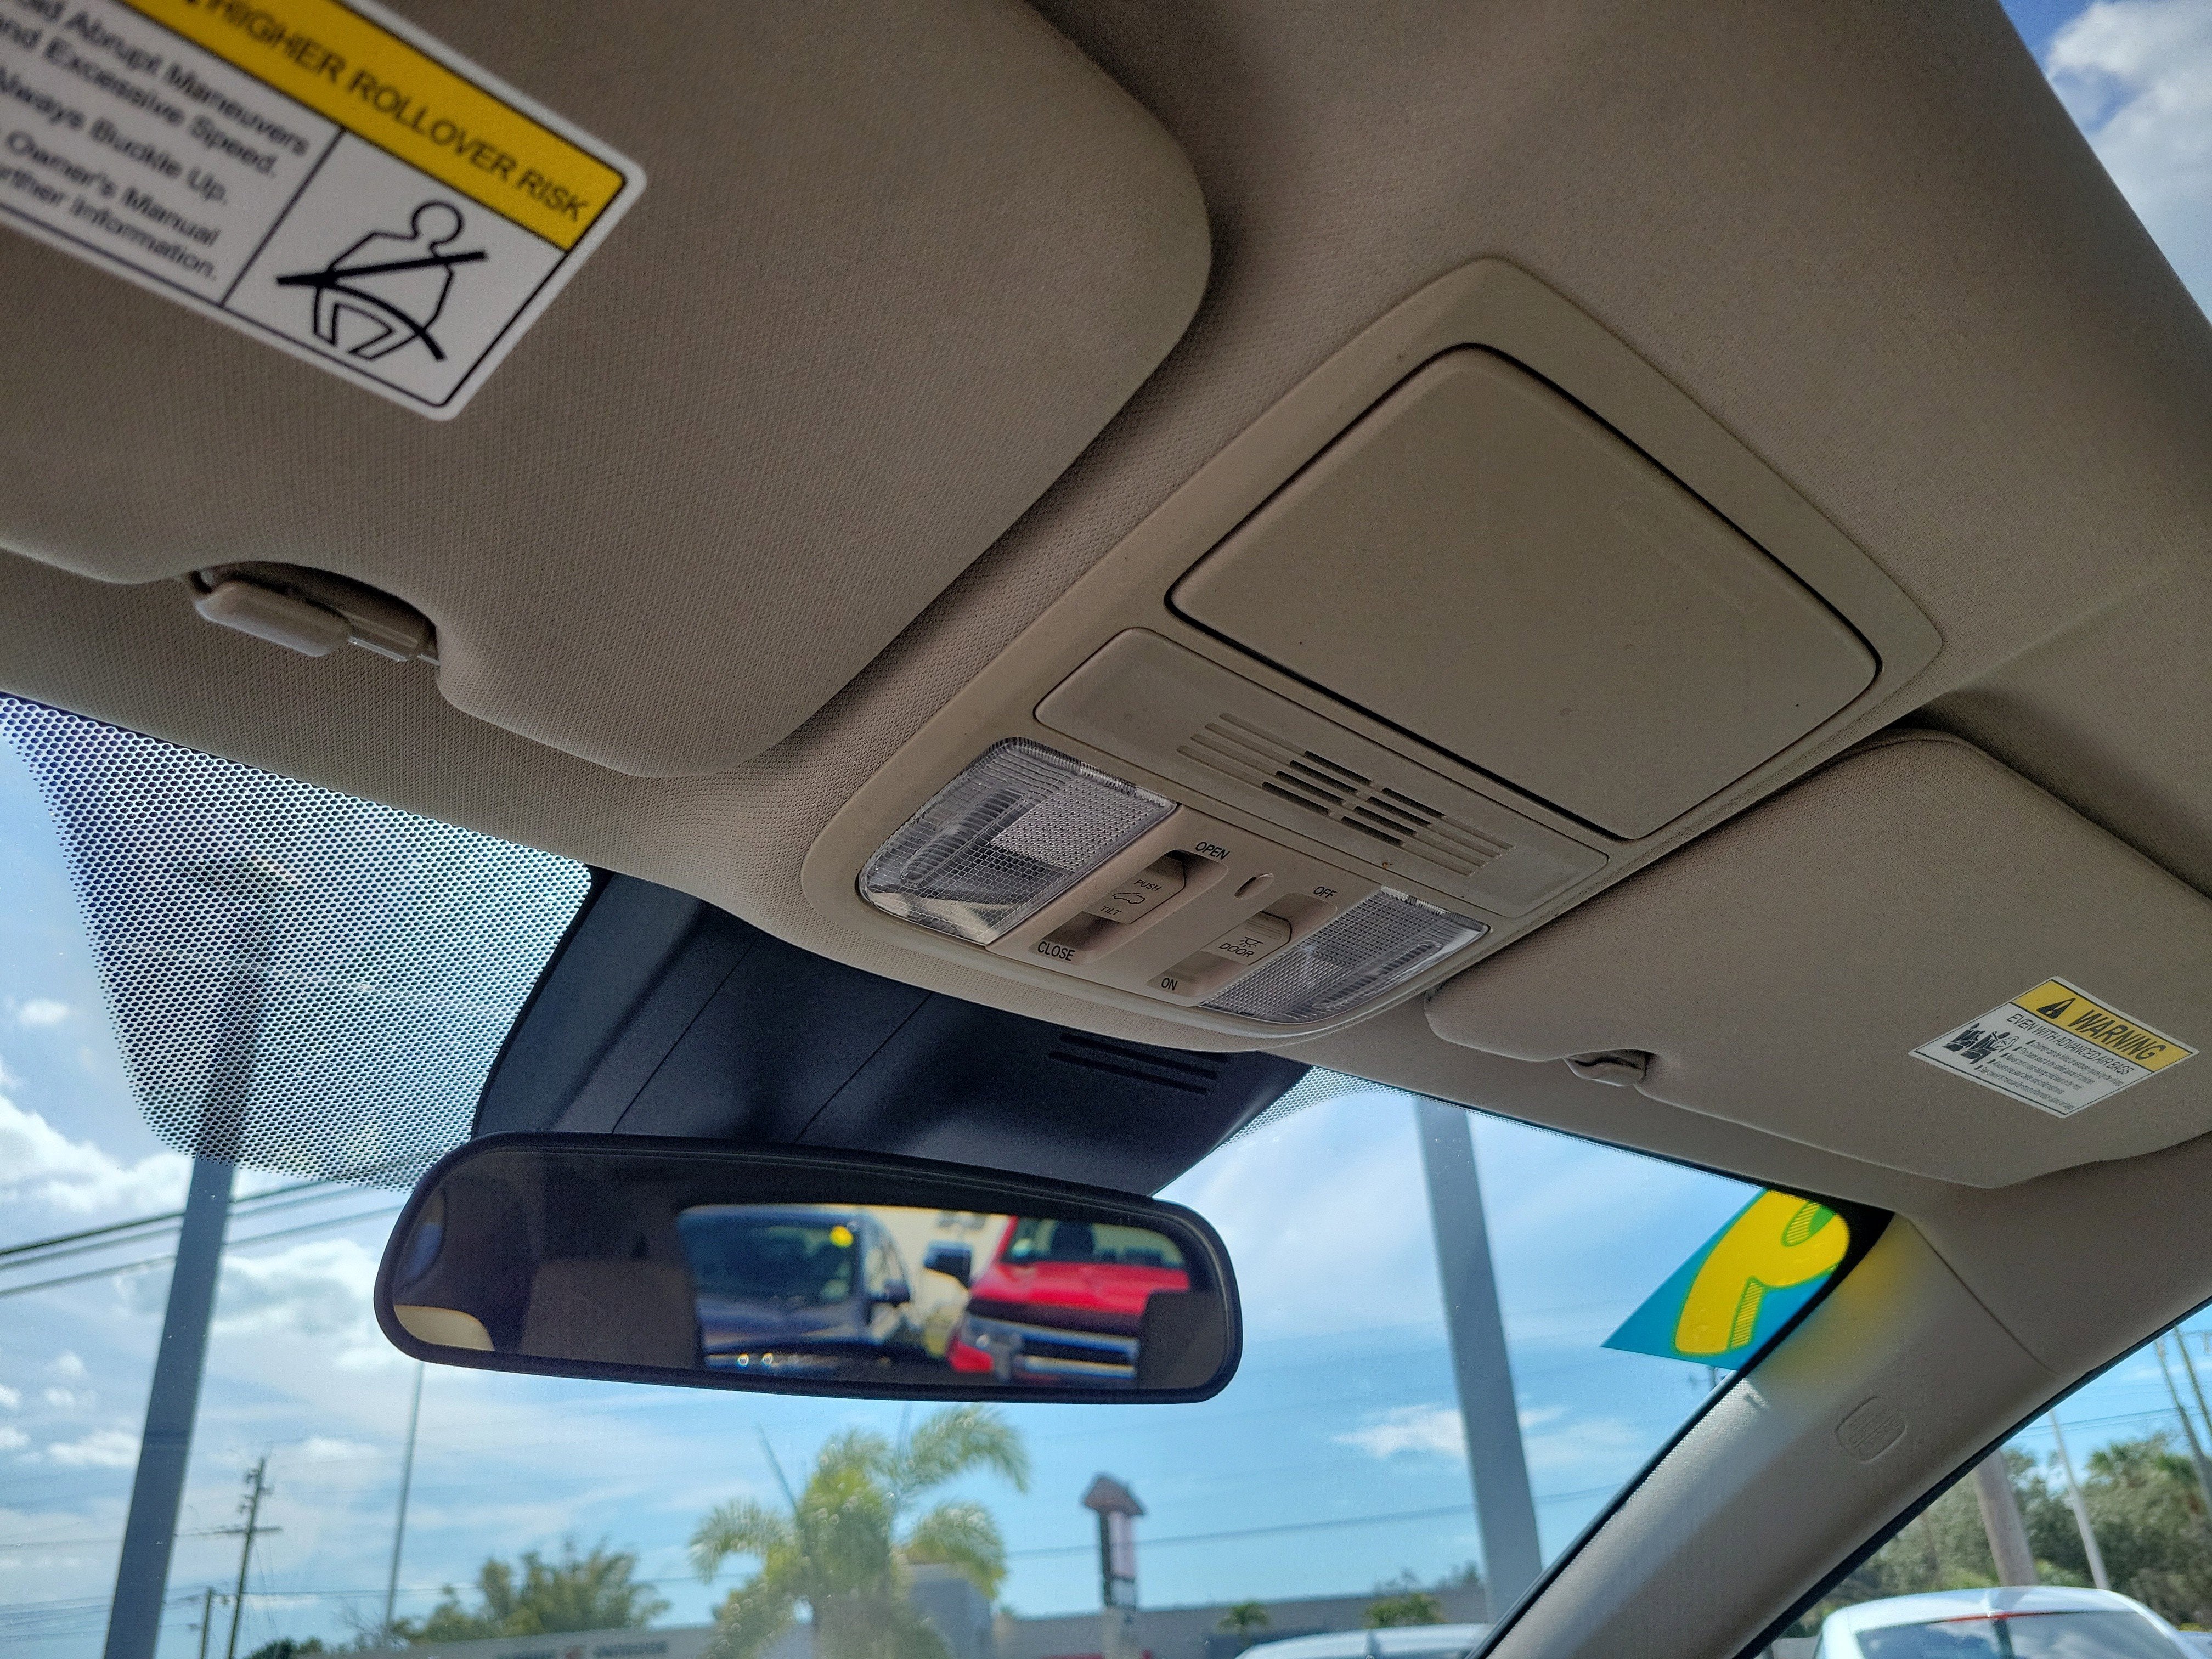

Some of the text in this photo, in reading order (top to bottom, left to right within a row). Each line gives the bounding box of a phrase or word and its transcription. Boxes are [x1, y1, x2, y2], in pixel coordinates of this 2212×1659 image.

[0, 14, 279, 179] nd Excessive Speed.
[62, 10, 311, 158] Abrupt Maneuvers
[88, 116, 184, 180] Buckle
[185, 166, 229, 207] Up.
[348, 68, 516, 188] ROLLOVER
[516, 166, 590, 224] RISK
[5, 129, 222, 247] Owner's Manual
[69, 193, 218, 282] Information.
[1195, 841, 1231, 860] OPEN
[1099, 905, 1122, 916] TILT
[1134, 879, 1163, 891] PUSH
[1313, 885, 1338, 899] OFF
[1037, 941, 1076, 962] CLOSE
[1218, 942, 1256, 958] DOOR
[1160, 977, 1179, 991] ON
[2006, 1013, 2135, 1075] EVEN WITH ADVANCED AIR BAGS
[2068, 1009, 2166, 1060] WARNING
